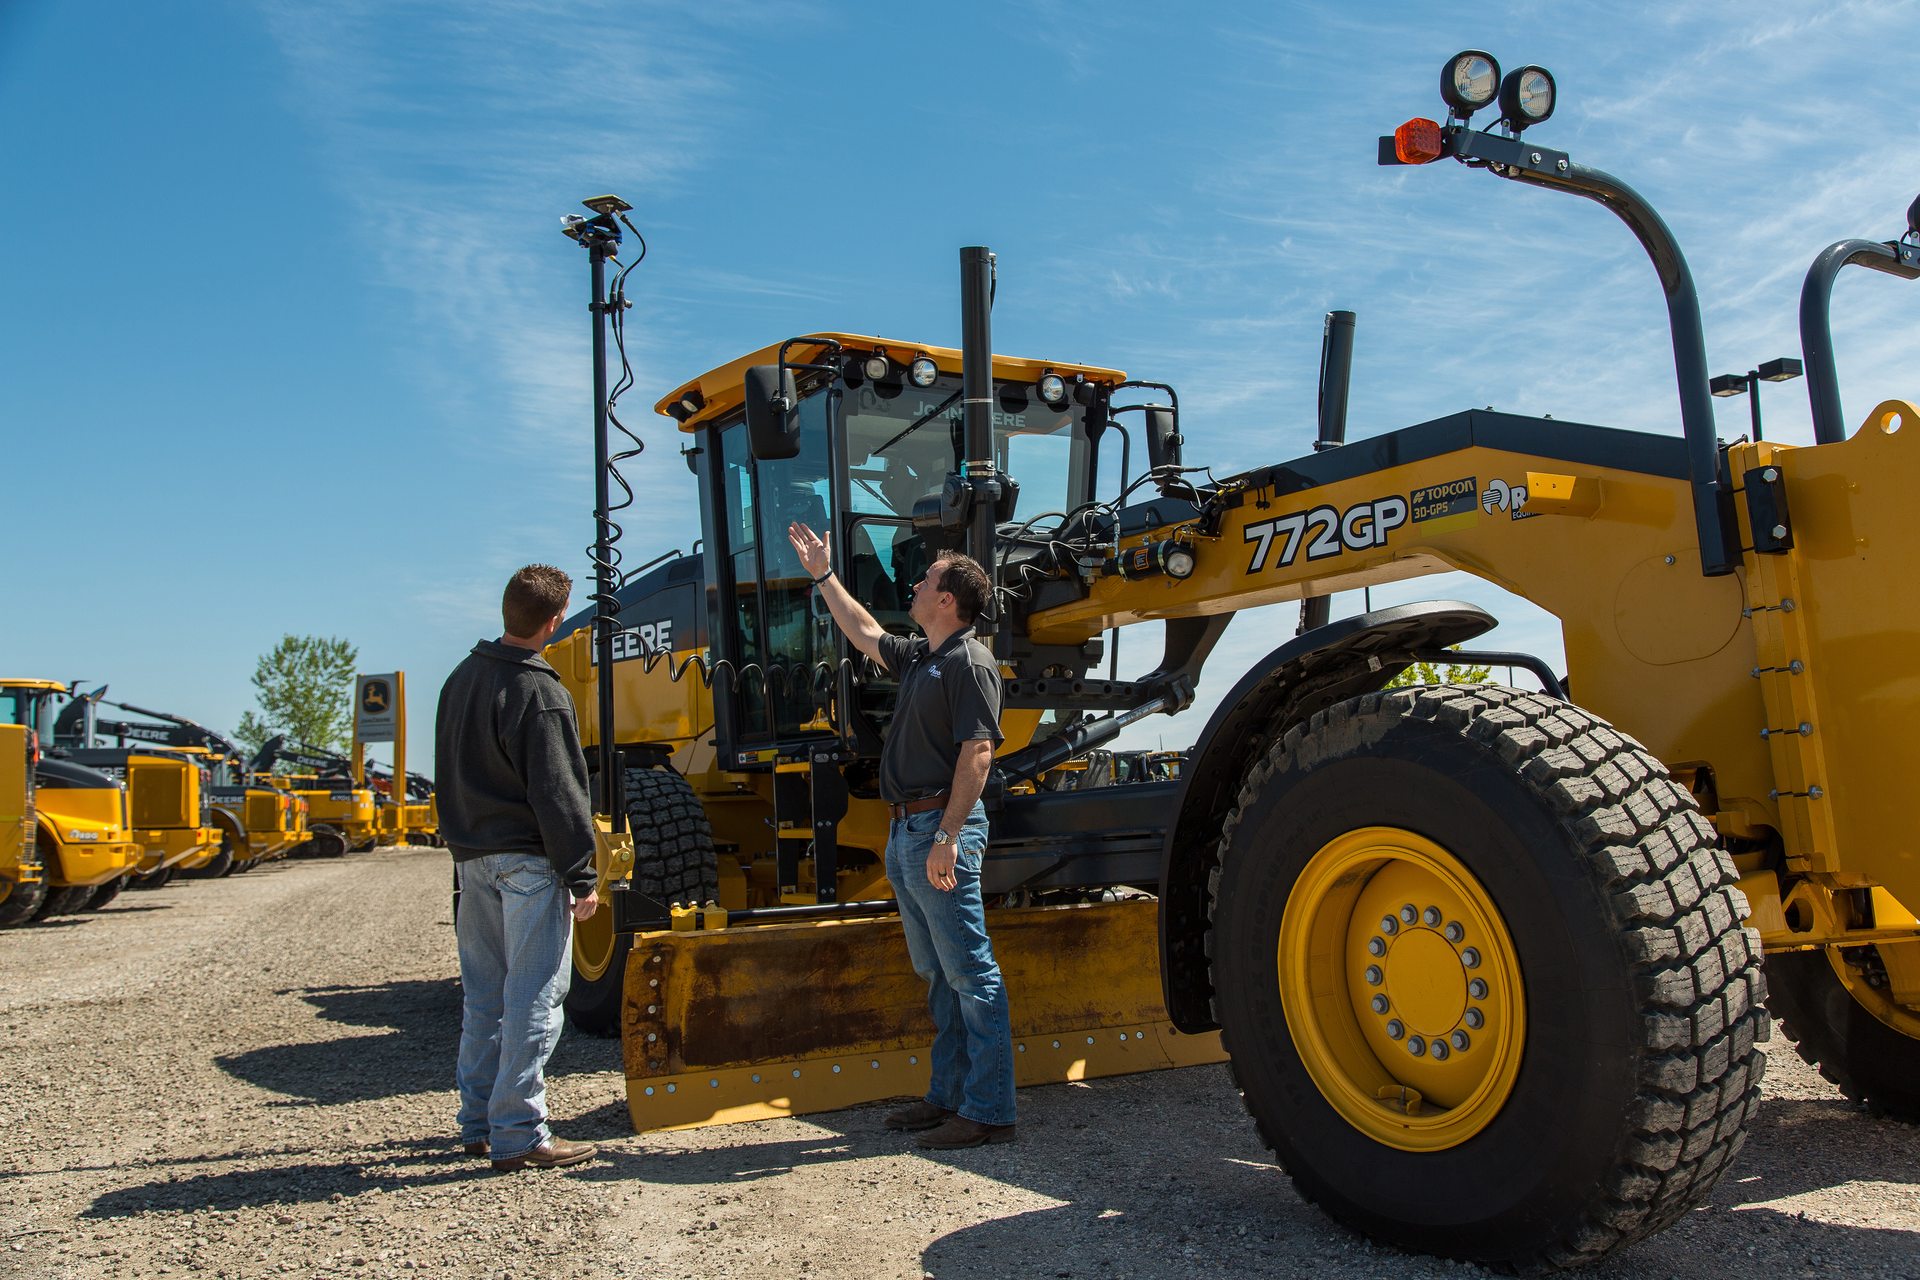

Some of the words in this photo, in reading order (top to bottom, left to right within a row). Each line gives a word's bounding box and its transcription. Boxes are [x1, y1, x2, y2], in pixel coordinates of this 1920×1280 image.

[1426, 480, 1475, 501] TOPCON
[1413, 501, 1449, 519] 3D-GPS
[1245, 497, 1408, 573] 772GP
